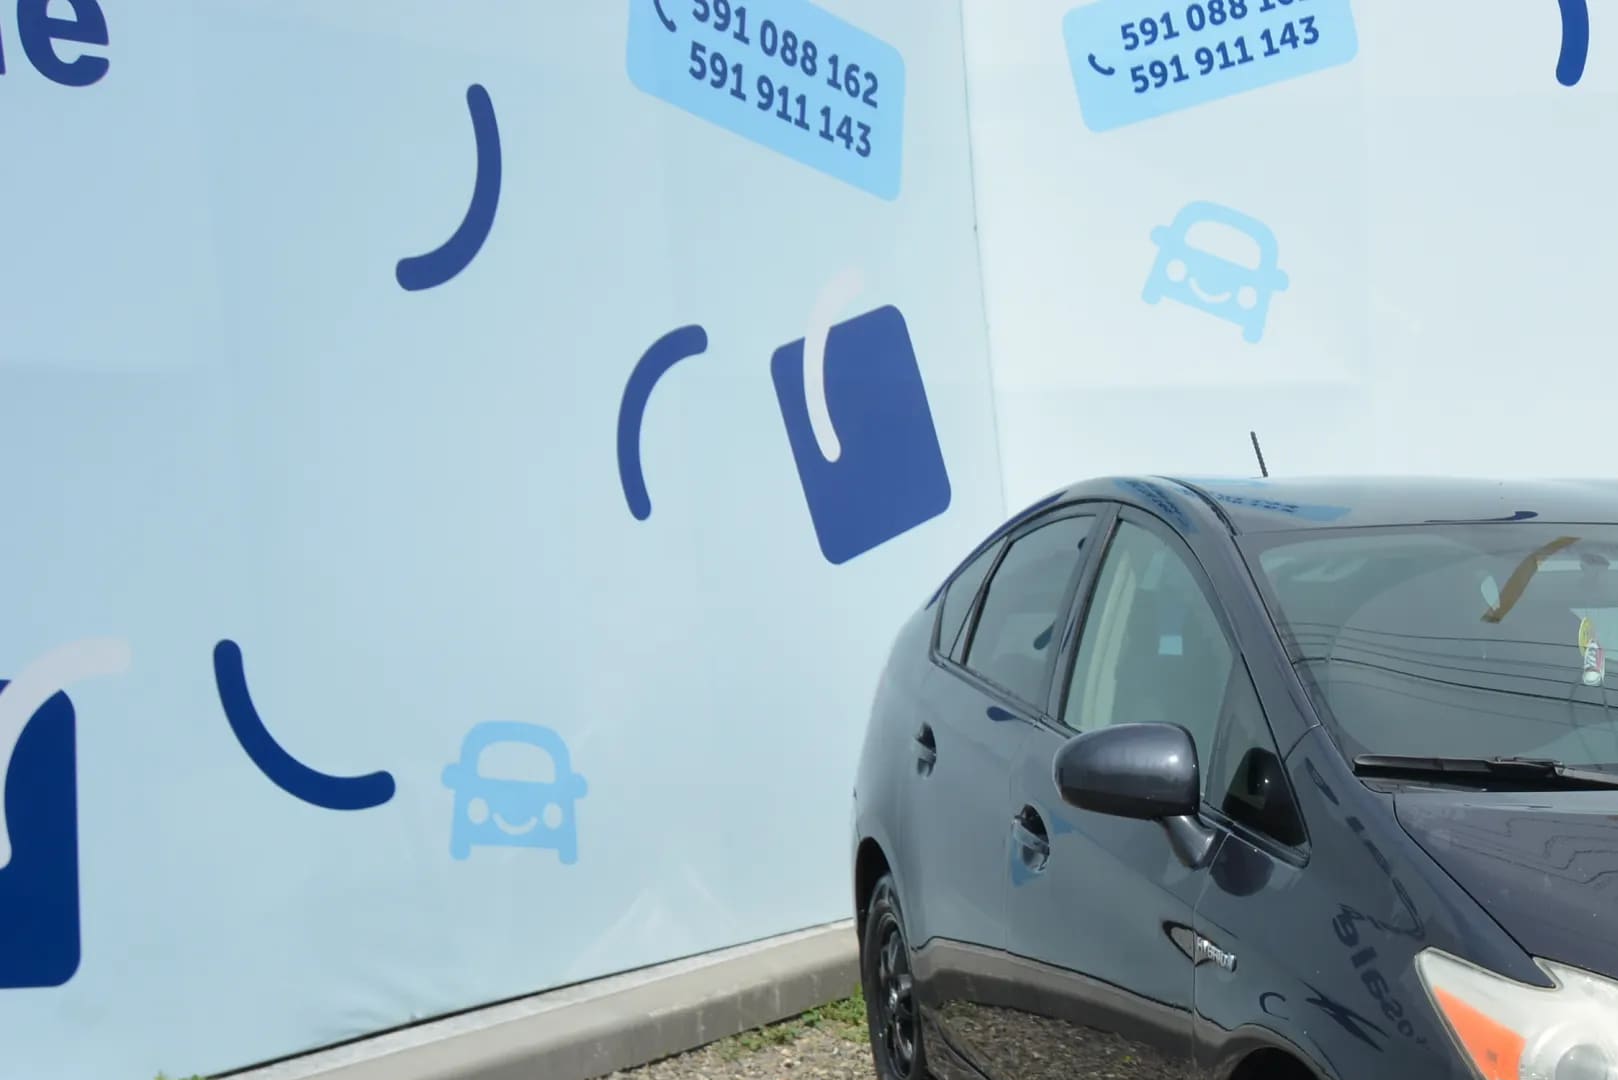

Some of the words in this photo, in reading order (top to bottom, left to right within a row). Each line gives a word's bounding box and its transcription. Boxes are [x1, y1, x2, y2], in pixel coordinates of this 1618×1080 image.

[0, 0, 110, 88] e
[691, 0, 751, 46] 591
[759, 18, 818, 78] 088
[826, 53, 879, 110] 162
[1120, 11, 1180, 51] 591
[1185, 0, 1248, 32] 088
[1129, 53, 1190, 94] 591
[1194, 35, 1255, 76] 911
[1259, 15, 1320, 58] 143
[688, 39, 748, 103] 591
[756, 74, 811, 133] 911
[818, 104, 872, 158] 143
